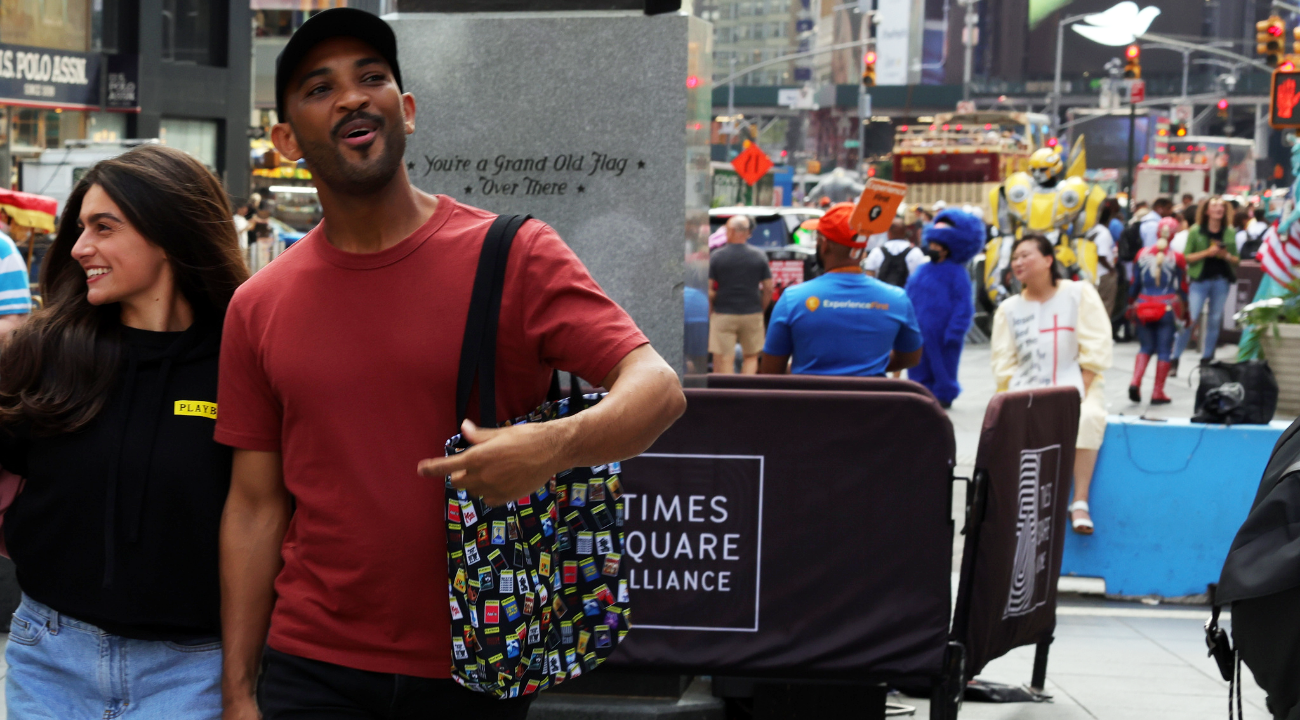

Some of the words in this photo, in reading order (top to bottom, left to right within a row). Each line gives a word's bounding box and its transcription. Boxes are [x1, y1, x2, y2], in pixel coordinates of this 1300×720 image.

[15, 51, 52, 82] POLO
[52, 55, 89, 85] ASSN.
[423, 154, 471, 177] You're
[476, 158, 488, 172] a
[494, 154, 548, 176] Grand
[553, 154, 585, 172] Old
[588, 151, 629, 177] Flag
[479, 176, 519, 196] Over
[523, 176, 568, 196] There
[179, 403, 217, 415] PLAYB
[622, 493, 729, 524] TIMES
[625, 530, 741, 564] QUARE
[629, 568, 732, 592] LLIANCE
